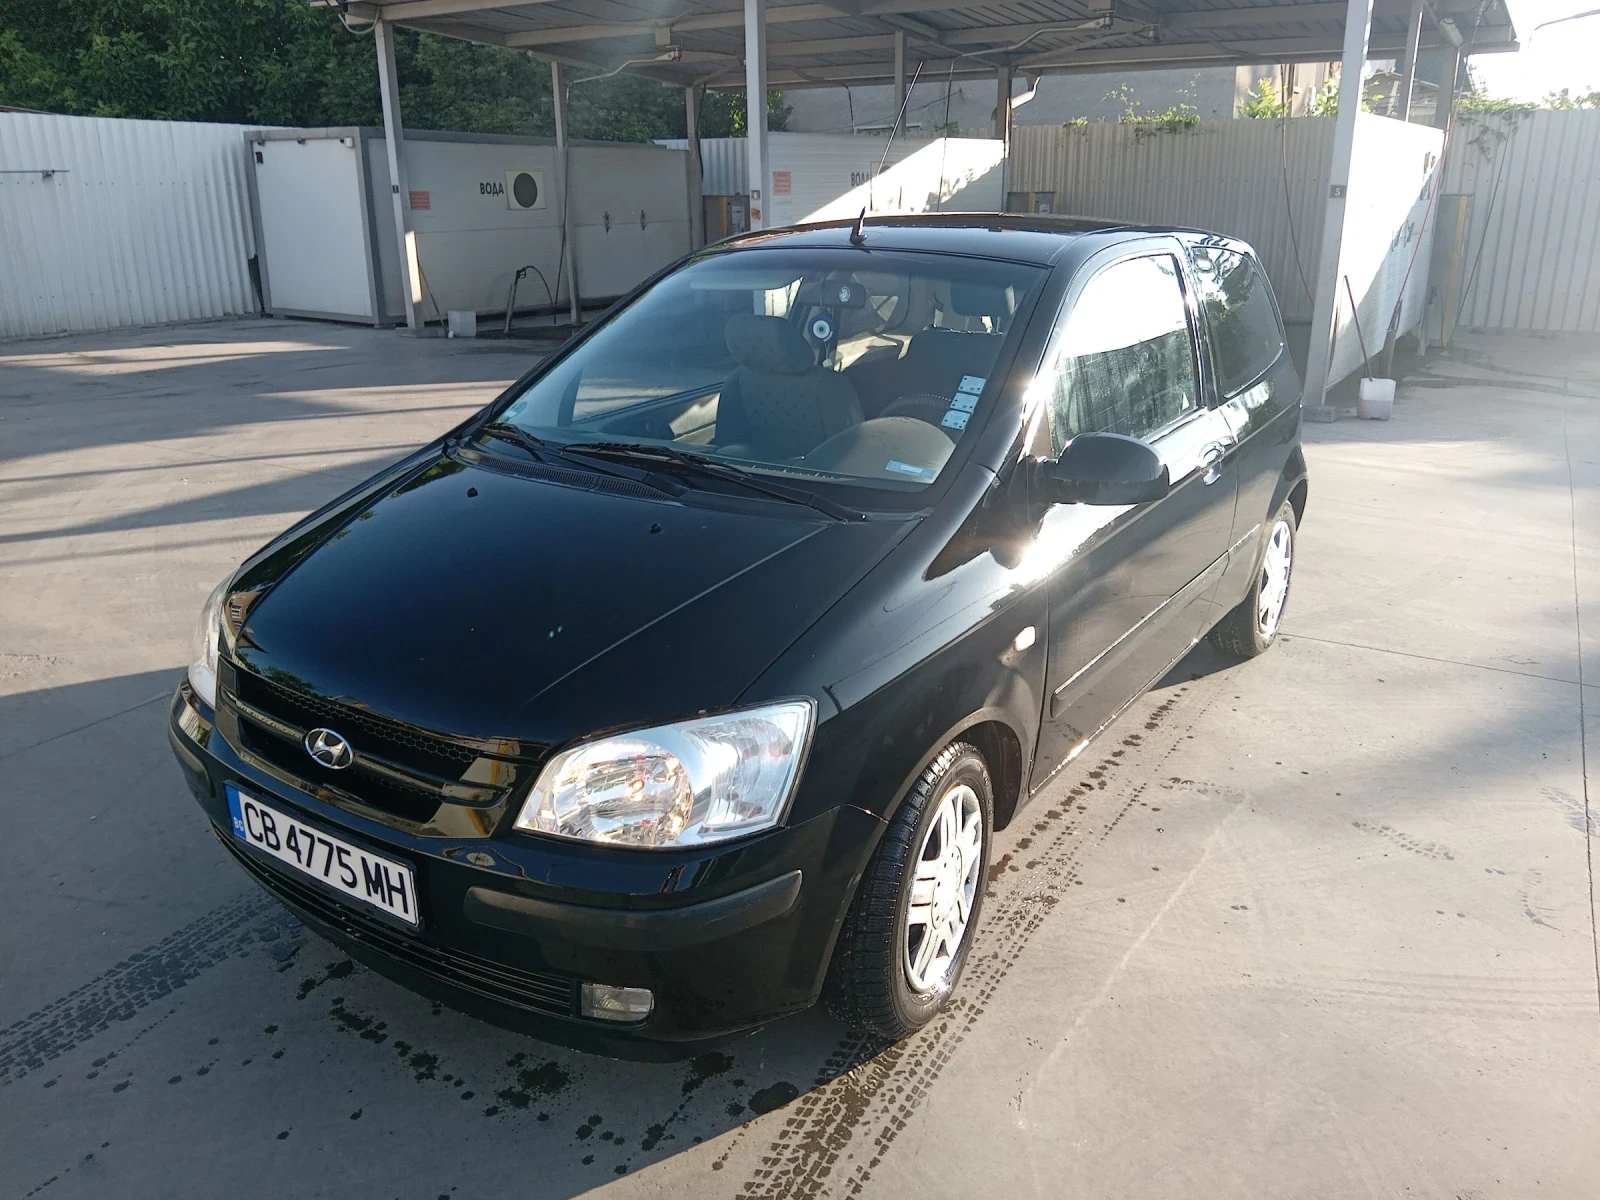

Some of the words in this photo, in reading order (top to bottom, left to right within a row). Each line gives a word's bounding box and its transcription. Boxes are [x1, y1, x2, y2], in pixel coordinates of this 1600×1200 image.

[479, 182, 504, 197] ВОДА
[233, 817, 244, 832] BG
[243, 801, 281, 852] CB
[286, 824, 358, 889] 4775
[360, 855, 410, 915] MH
